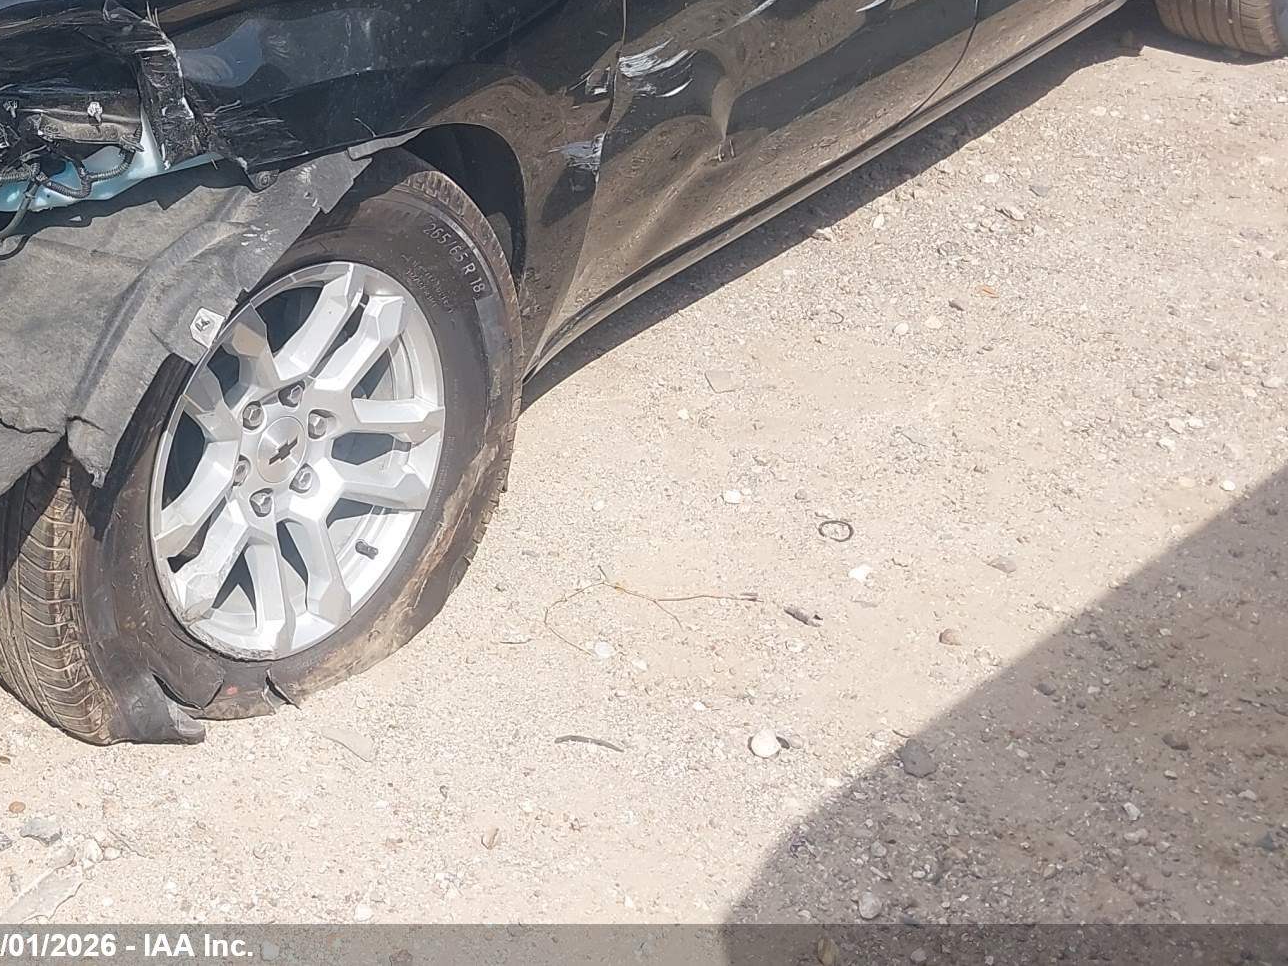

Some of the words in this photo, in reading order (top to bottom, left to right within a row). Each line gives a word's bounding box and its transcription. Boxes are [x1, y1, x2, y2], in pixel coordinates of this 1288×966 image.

[423, 222, 469, 263] 265/65
[463, 262, 477, 275] R
[469, 277, 486, 293] 18
